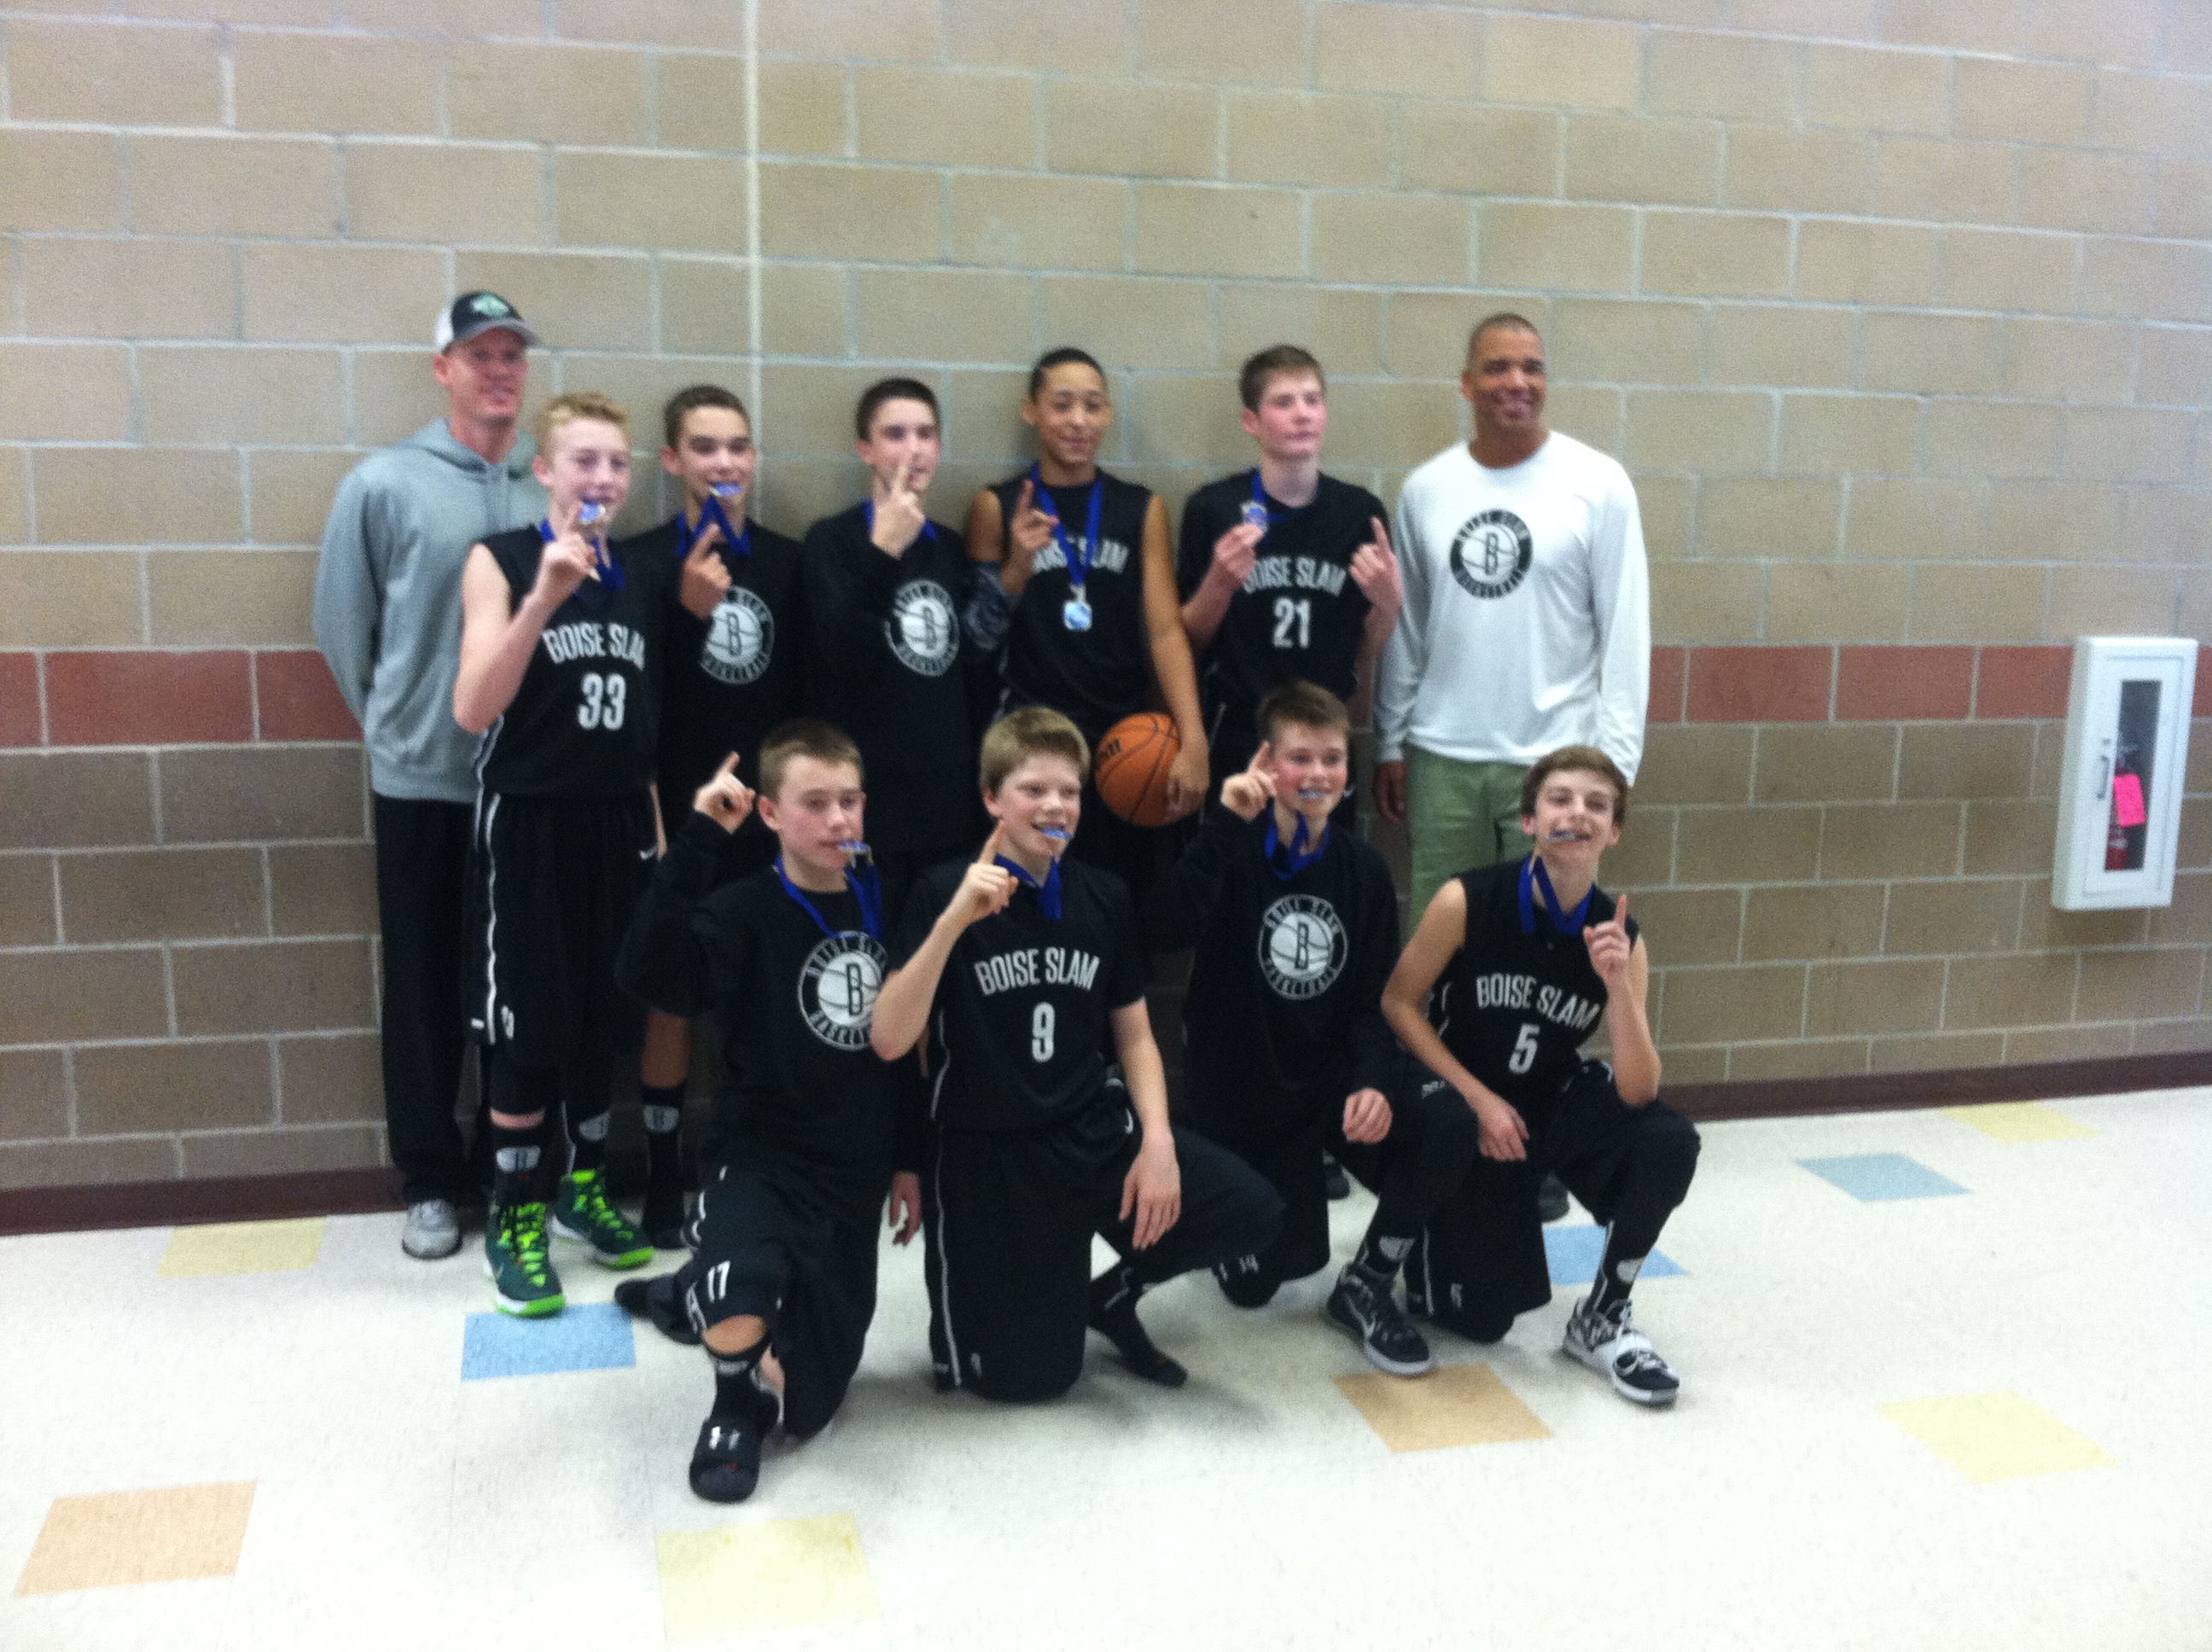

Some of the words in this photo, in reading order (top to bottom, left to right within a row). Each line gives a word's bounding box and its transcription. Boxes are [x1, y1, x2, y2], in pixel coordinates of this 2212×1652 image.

[1243, 556, 1292, 594] OISE
[1295, 556, 1347, 596] SLAM
[542, 621, 607, 665] BOISE
[1272, 597, 1311, 649] 21
[577, 672, 626, 731] 33
[846, 961, 864, 1016] B
[974, 948, 1040, 996] BOISE
[1045, 946, 1100, 991] SLAM
[1476, 972, 1537, 1009] BOISE
[1537, 985, 1601, 1030] SLAM
[1032, 1001, 1056, 1063] 9
[1508, 1022, 1540, 1075] 5
[707, 1259, 731, 1304] 17
